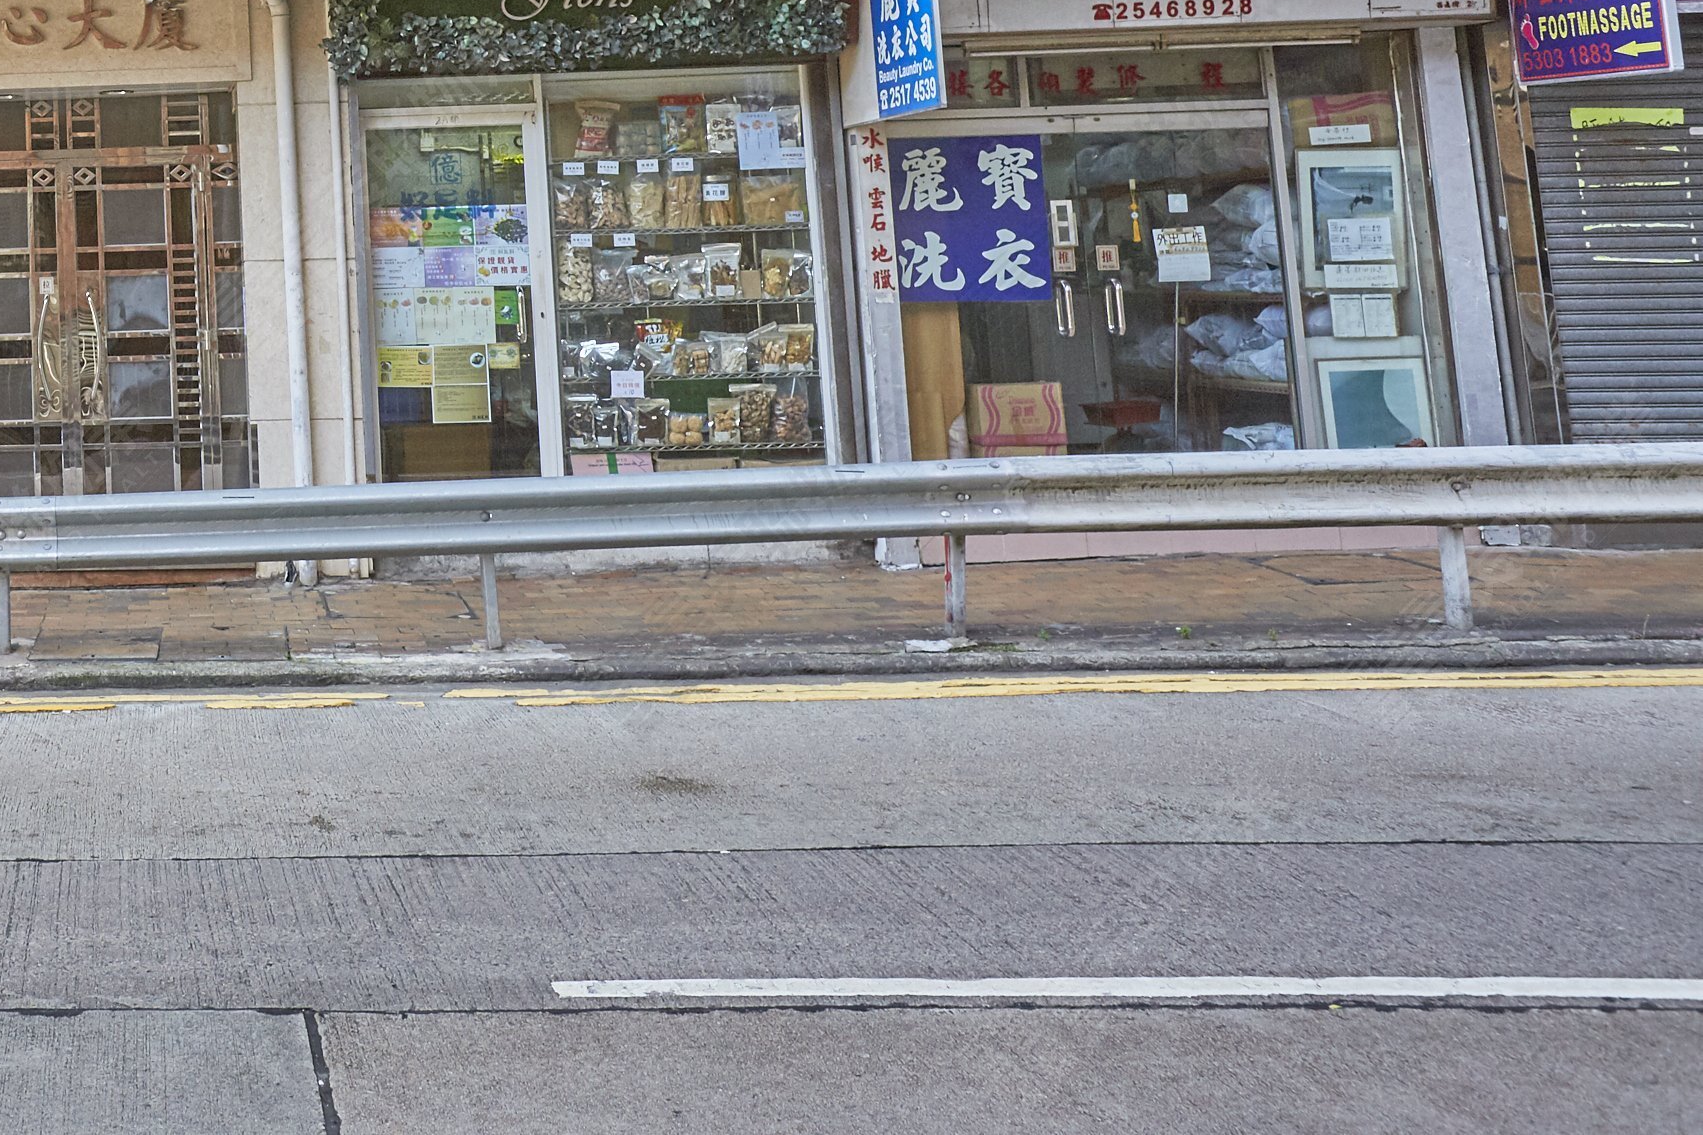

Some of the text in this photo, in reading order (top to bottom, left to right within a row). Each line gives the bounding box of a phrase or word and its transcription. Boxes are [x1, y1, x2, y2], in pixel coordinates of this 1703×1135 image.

[1538, 1, 1654, 41] FOOTMASSAGE
[877, 13, 933, 65] 洗衣公司
[879, 57, 935, 84] Beauty Laundry Co.
[1523, 43, 1613, 71] 5303 1883
[889, 77, 937, 109] 2517 4539
[899, 143, 1038, 212] 麗寶
[899, 229, 1047, 292] 洗衣
[1058, 251, 1069, 263] 推
[1101, 250, 1113, 263] 推
